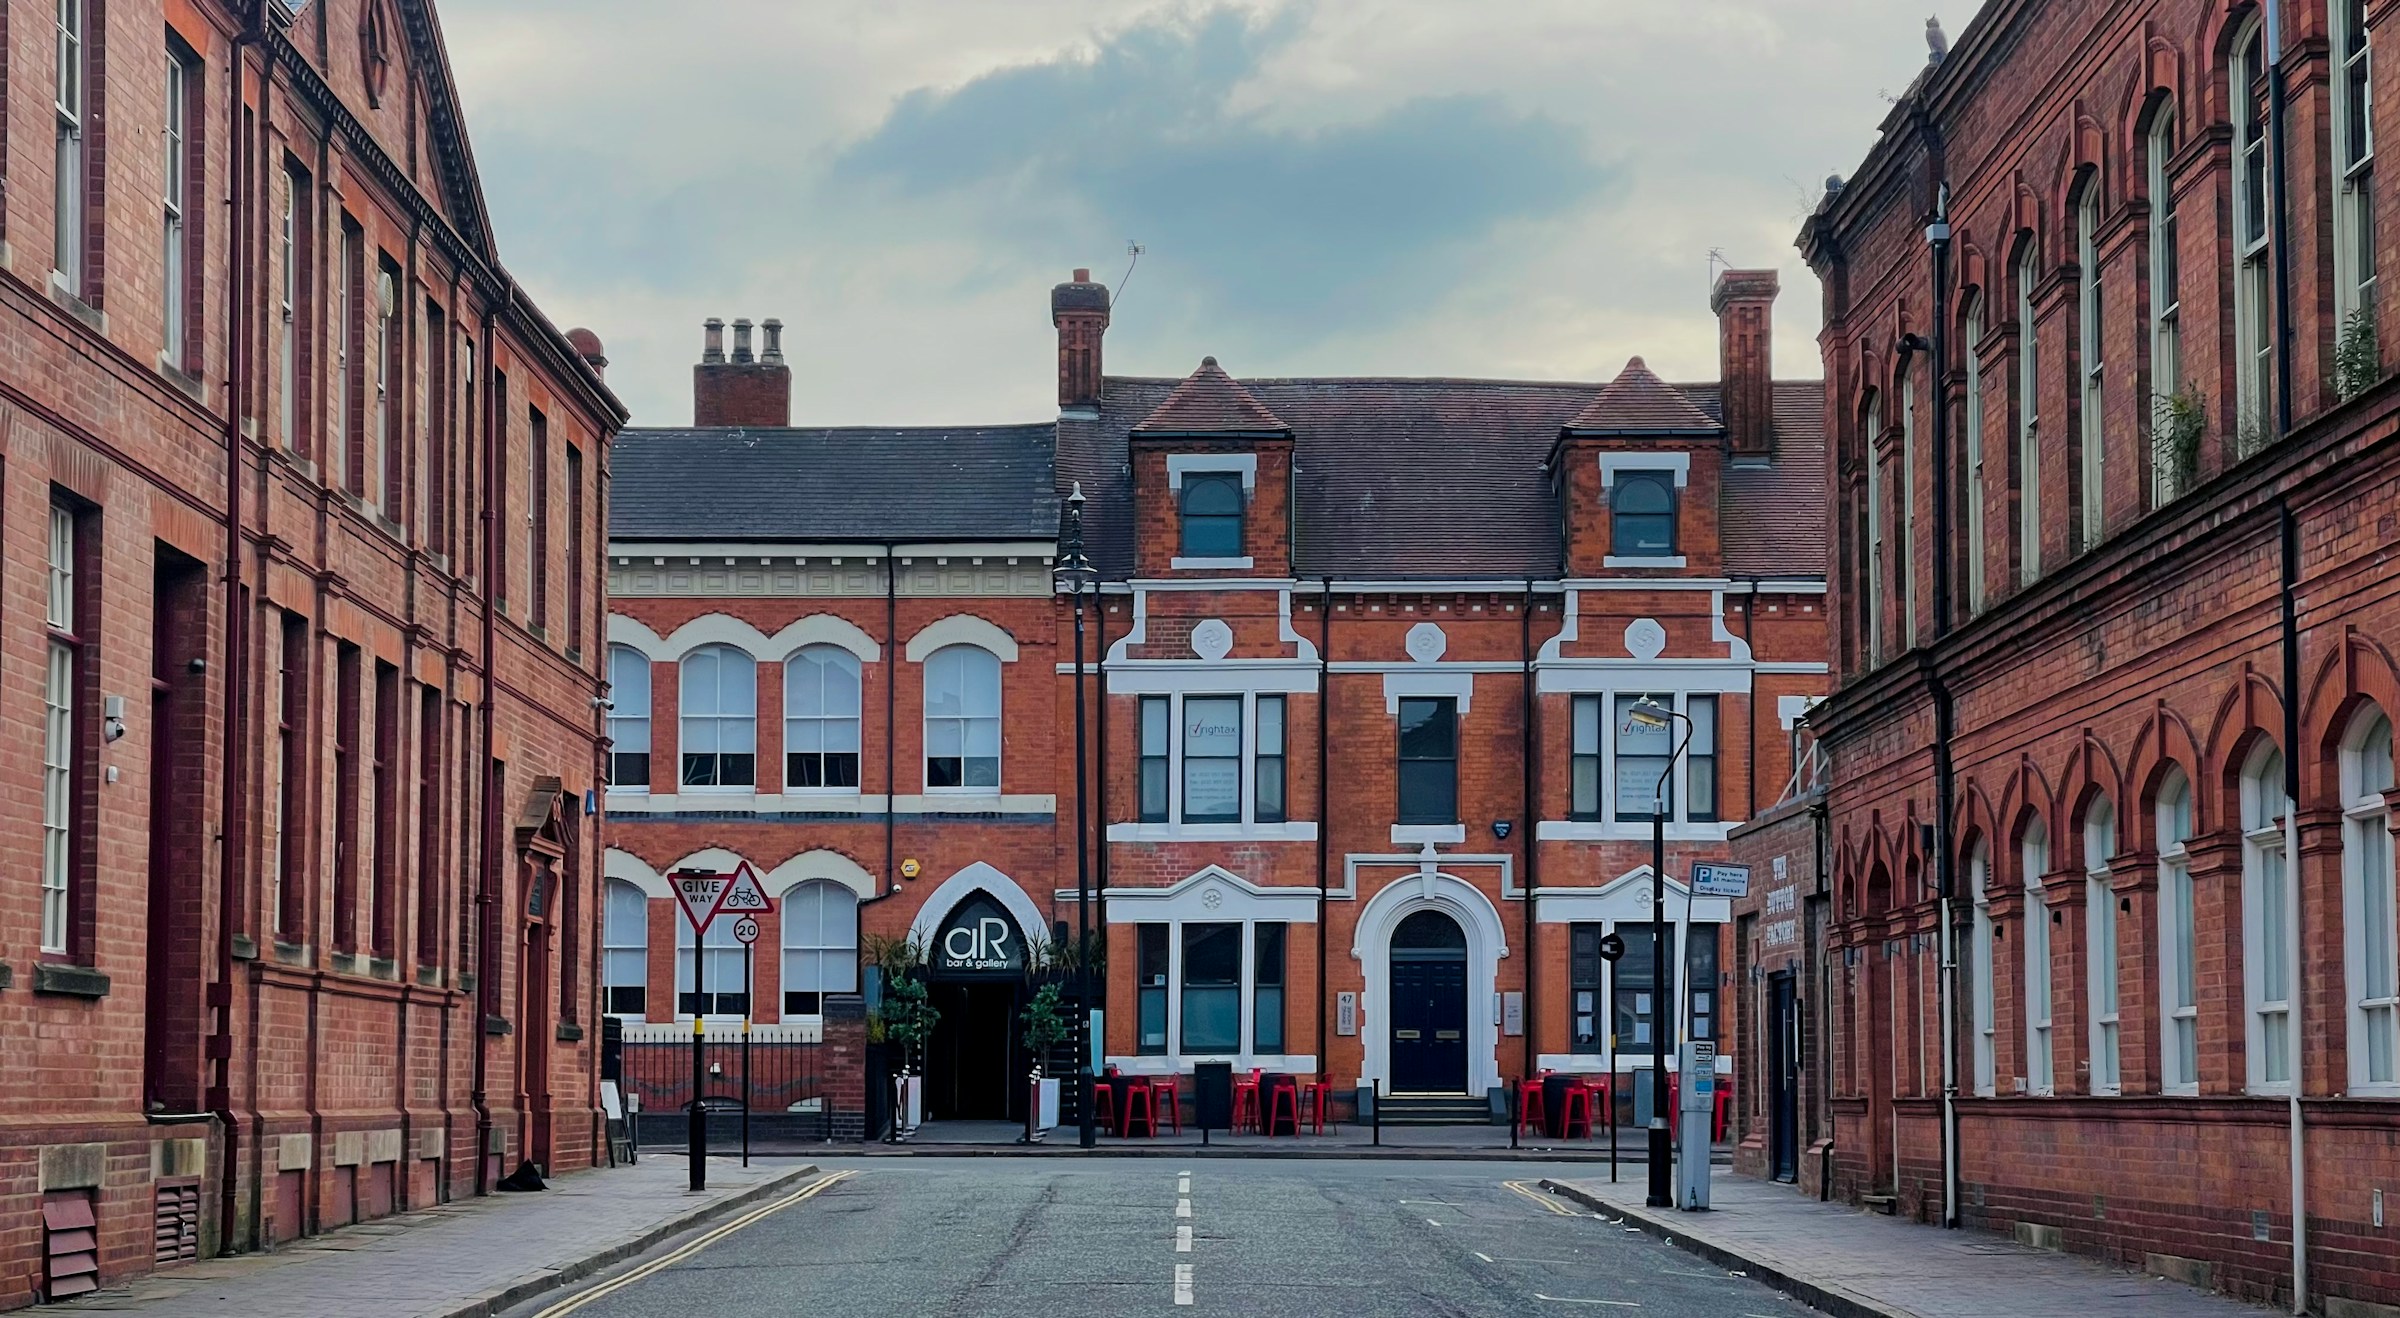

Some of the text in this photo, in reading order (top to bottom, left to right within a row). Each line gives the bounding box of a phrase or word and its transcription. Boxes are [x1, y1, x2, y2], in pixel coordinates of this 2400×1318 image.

[1201, 725, 1236, 736] rightax
[1699, 868, 1711, 882] P
[682, 880, 720, 893] GIVE
[689, 894, 713, 903] WAY
[737, 925, 756, 936] 20
[946, 958, 1009, 970] bar & gallery
[1341, 994, 1353, 1004] 47
